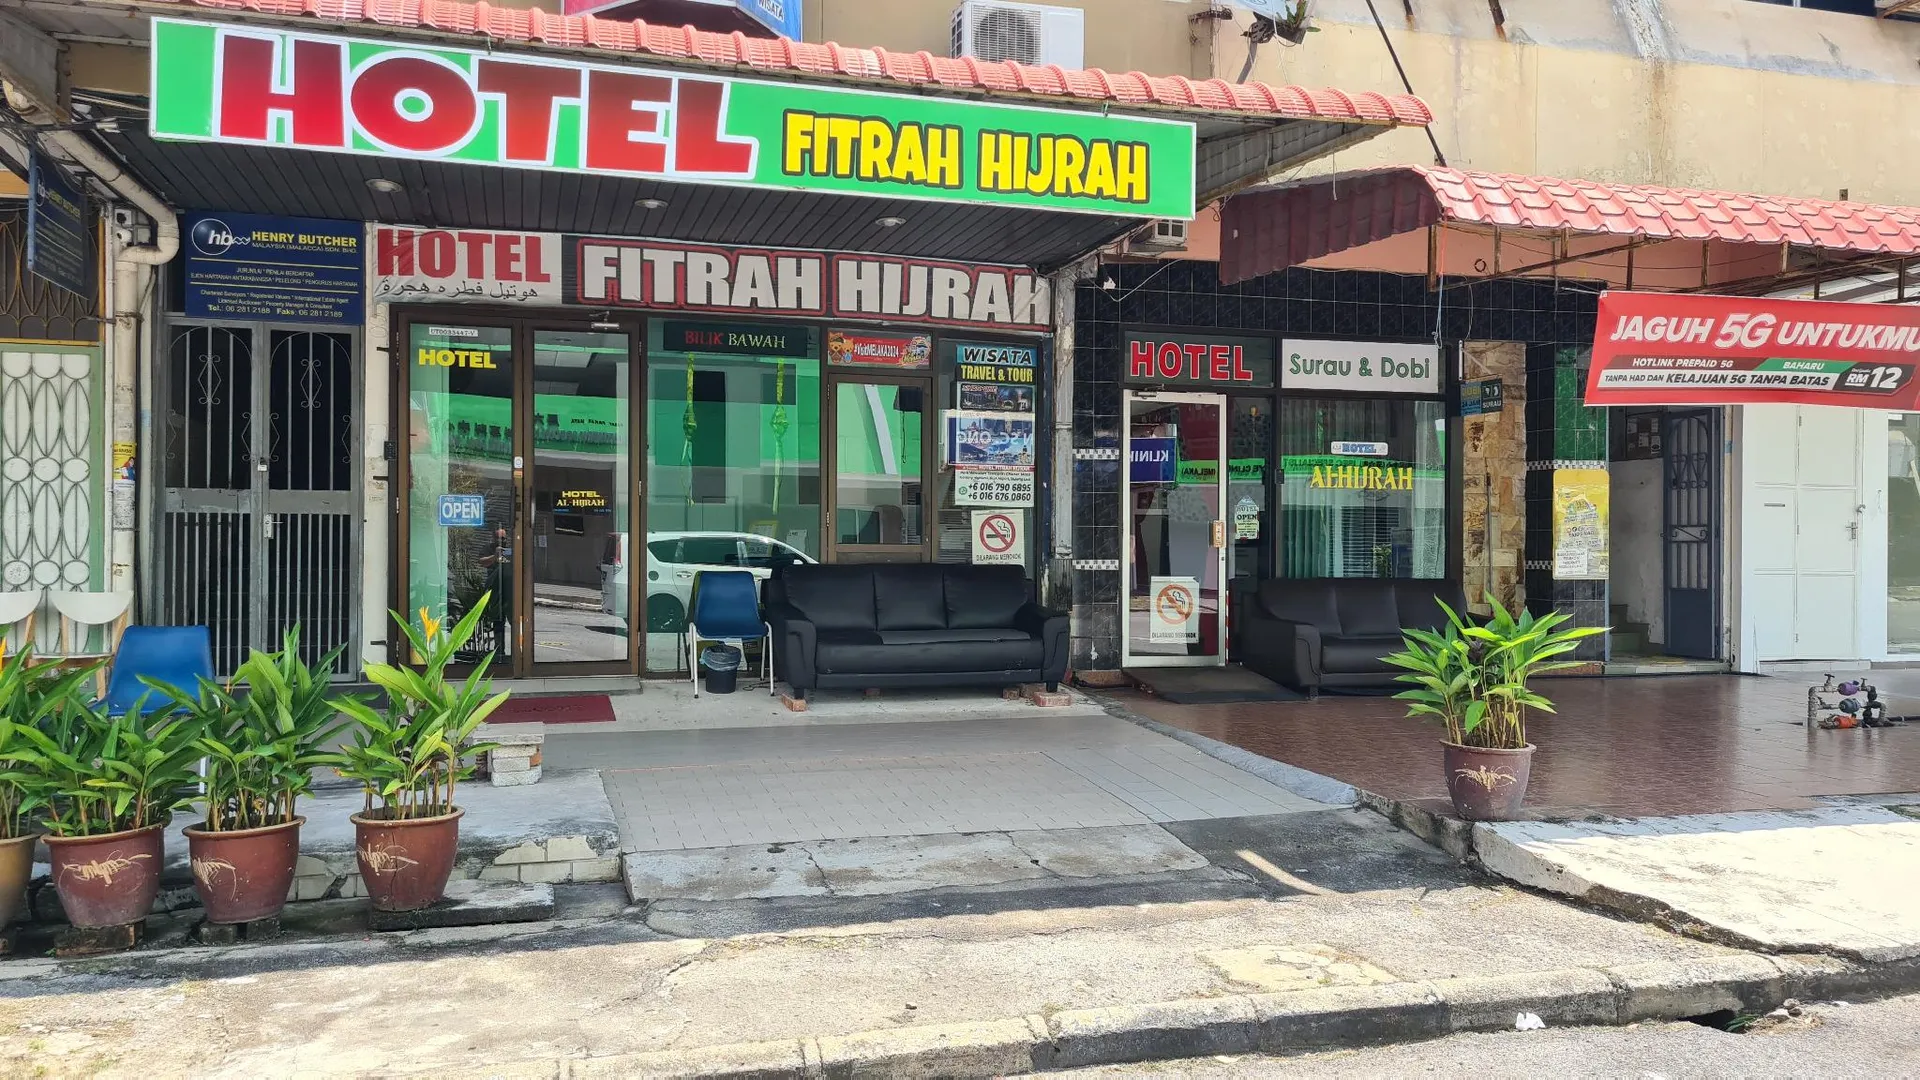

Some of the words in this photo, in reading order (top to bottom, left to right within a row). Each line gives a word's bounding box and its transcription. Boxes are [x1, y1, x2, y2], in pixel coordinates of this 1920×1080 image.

[219, 34, 757, 180] HOTEL
[785, 113, 960, 186] FITRAH
[980, 132, 1149, 201] HIJRAH
[208, 230, 232, 246] hb
[252, 231, 295, 243] HENRY
[299, 234, 357, 247] BUTCHER
[252, 242, 286, 250] MALAYSIA
[378, 228, 551, 283] HOTEL
[583, 244, 821, 310] FITRAH
[838, 260, 1050, 325] HIJRAH
[1610, 315, 1716, 343] JAGUH
[1714, 313, 1778, 349] 5G
[685, 331, 724, 345] BILIK
[728, 333, 786, 348] BAWAH
[418, 348, 497, 369] HOTEL
[964, 347, 1032, 365] WISATA
[1131, 341, 1253, 381] HOTEL
[1289, 353, 1351, 376] Surau
[1358, 356, 1373, 377] &
[1381, 356, 1430, 378] Dobi
[1632, 357, 1675, 368] HOTLINK
[1675, 358, 1717, 368] PREPAID
[1720, 360, 1733, 368] 5G
[961, 364, 996, 380] TRAVEL
[998, 368, 1006, 381] &
[1007, 367, 1033, 382] TOUR
[1783, 361, 1824, 371] BAHARU
[1604, 374, 1627, 382] TANPA
[1628, 374, 1646, 383] HAD
[1647, 375, 1664, 383] DAN
[1666, 372, 1729, 385] KELAJUAN
[1729, 374, 1747, 384] 5G
[1750, 374, 1788, 385] TANPA
[1789, 375, 1831, 387] BATAS
[562, 490, 600, 498] HOTEL
[980, 483, 993, 491] 016
[996, 483, 1010, 491] 790
[1012, 484, 1031, 492] 6895
[968, 492, 978, 500] +6
[980, 492, 994, 500] 016
[995, 493, 1009, 501] 676
[1011, 493, 1031, 501] 0860
[442, 501, 480, 519] OPEN
